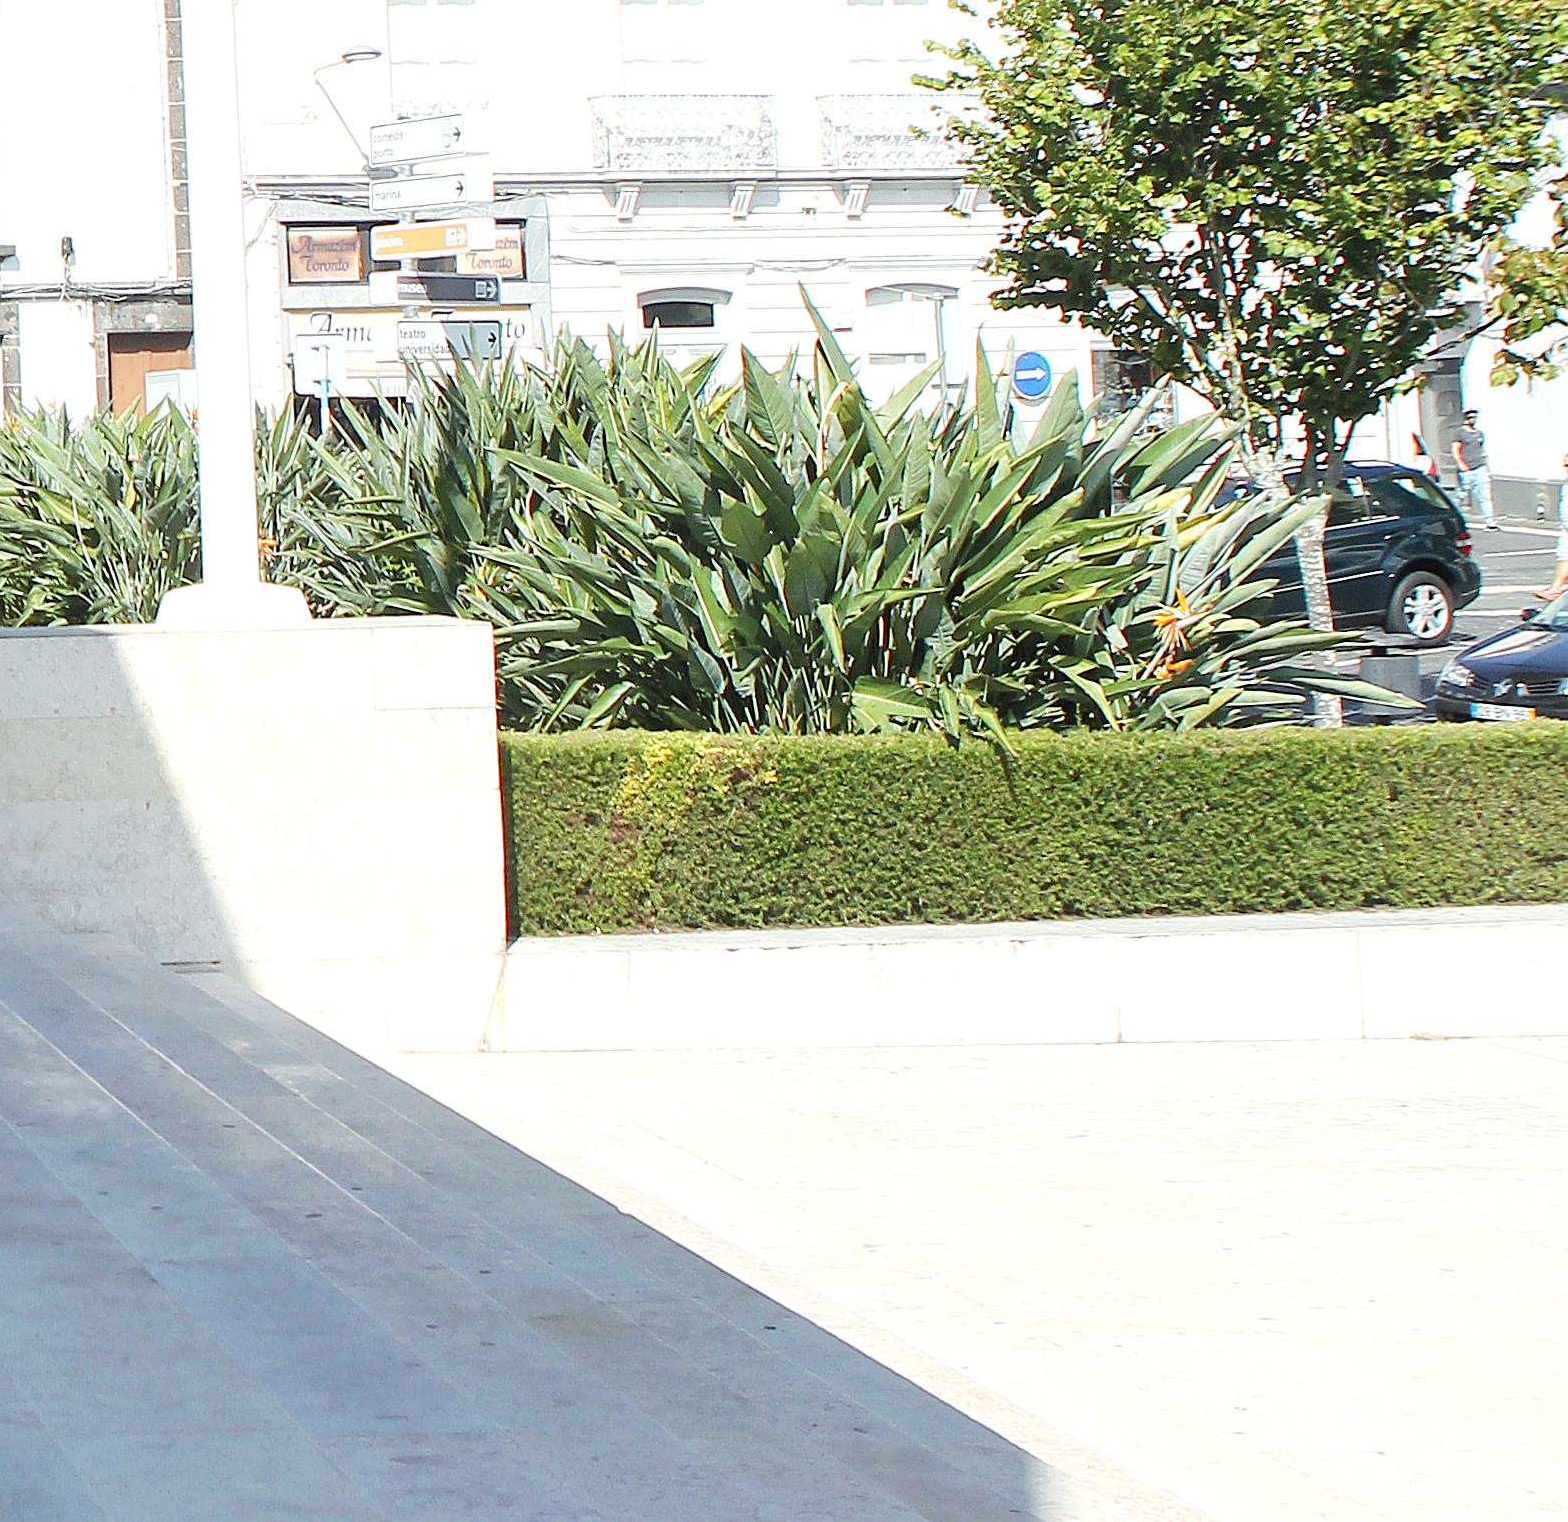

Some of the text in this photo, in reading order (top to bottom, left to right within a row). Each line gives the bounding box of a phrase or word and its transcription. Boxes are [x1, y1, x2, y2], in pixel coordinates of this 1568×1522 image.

[302, 255, 349, 271] Toronto
[468, 253, 512, 269] Toronto
[399, 329, 426, 339] teatro
